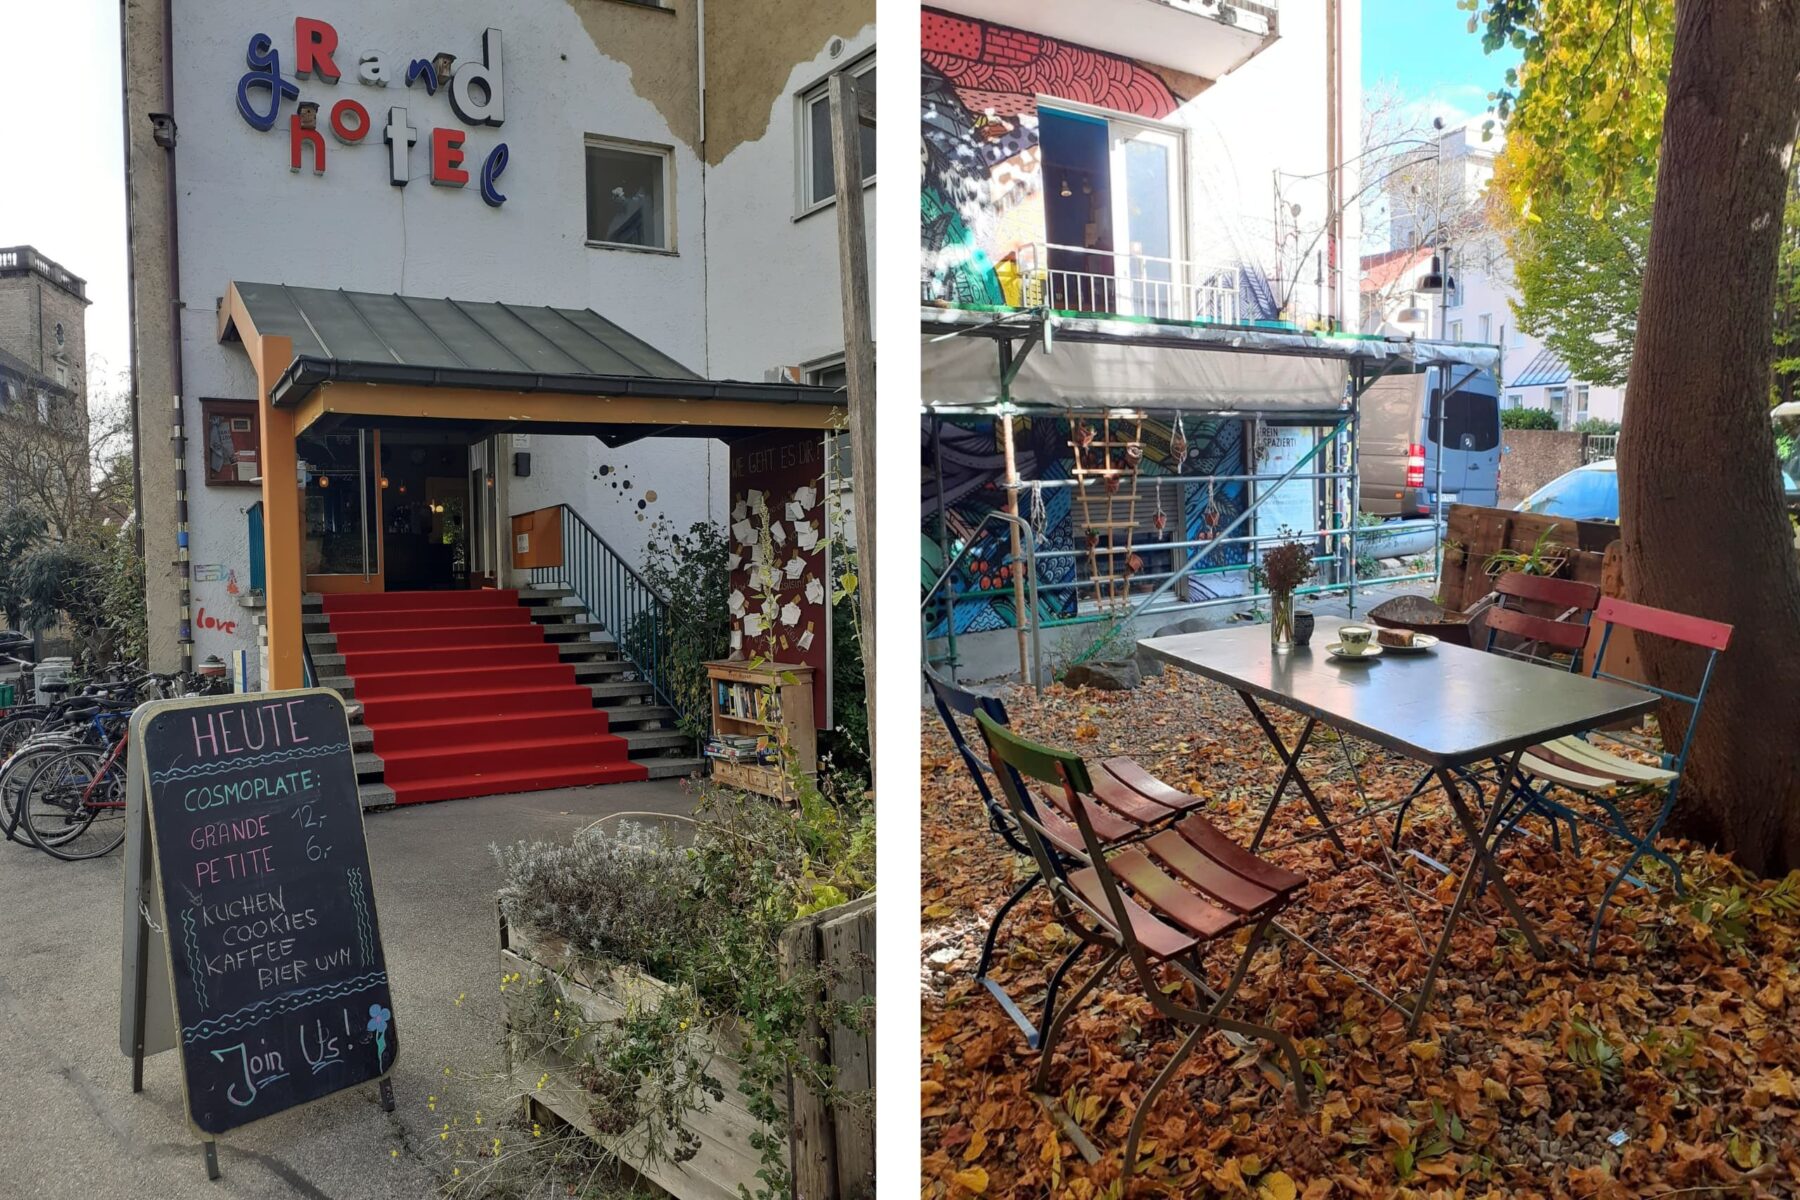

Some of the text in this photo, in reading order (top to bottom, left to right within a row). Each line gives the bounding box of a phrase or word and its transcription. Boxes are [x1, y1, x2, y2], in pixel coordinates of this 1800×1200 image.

[196, 607, 237, 635] love
[191, 699, 309, 757] HEUTE
[184, 769, 321, 812] COSMOPLATE:
[190, 814, 271, 850] GRANDE
[195, 845, 276, 887] PETITE
[203, 885, 285, 927] KUCHEN
[222, 908, 318, 946] COOKIES
[203, 937, 296, 976] KAFFEE
[258, 960, 308, 990] BIER
[210, 1038, 285, 1107] Join
